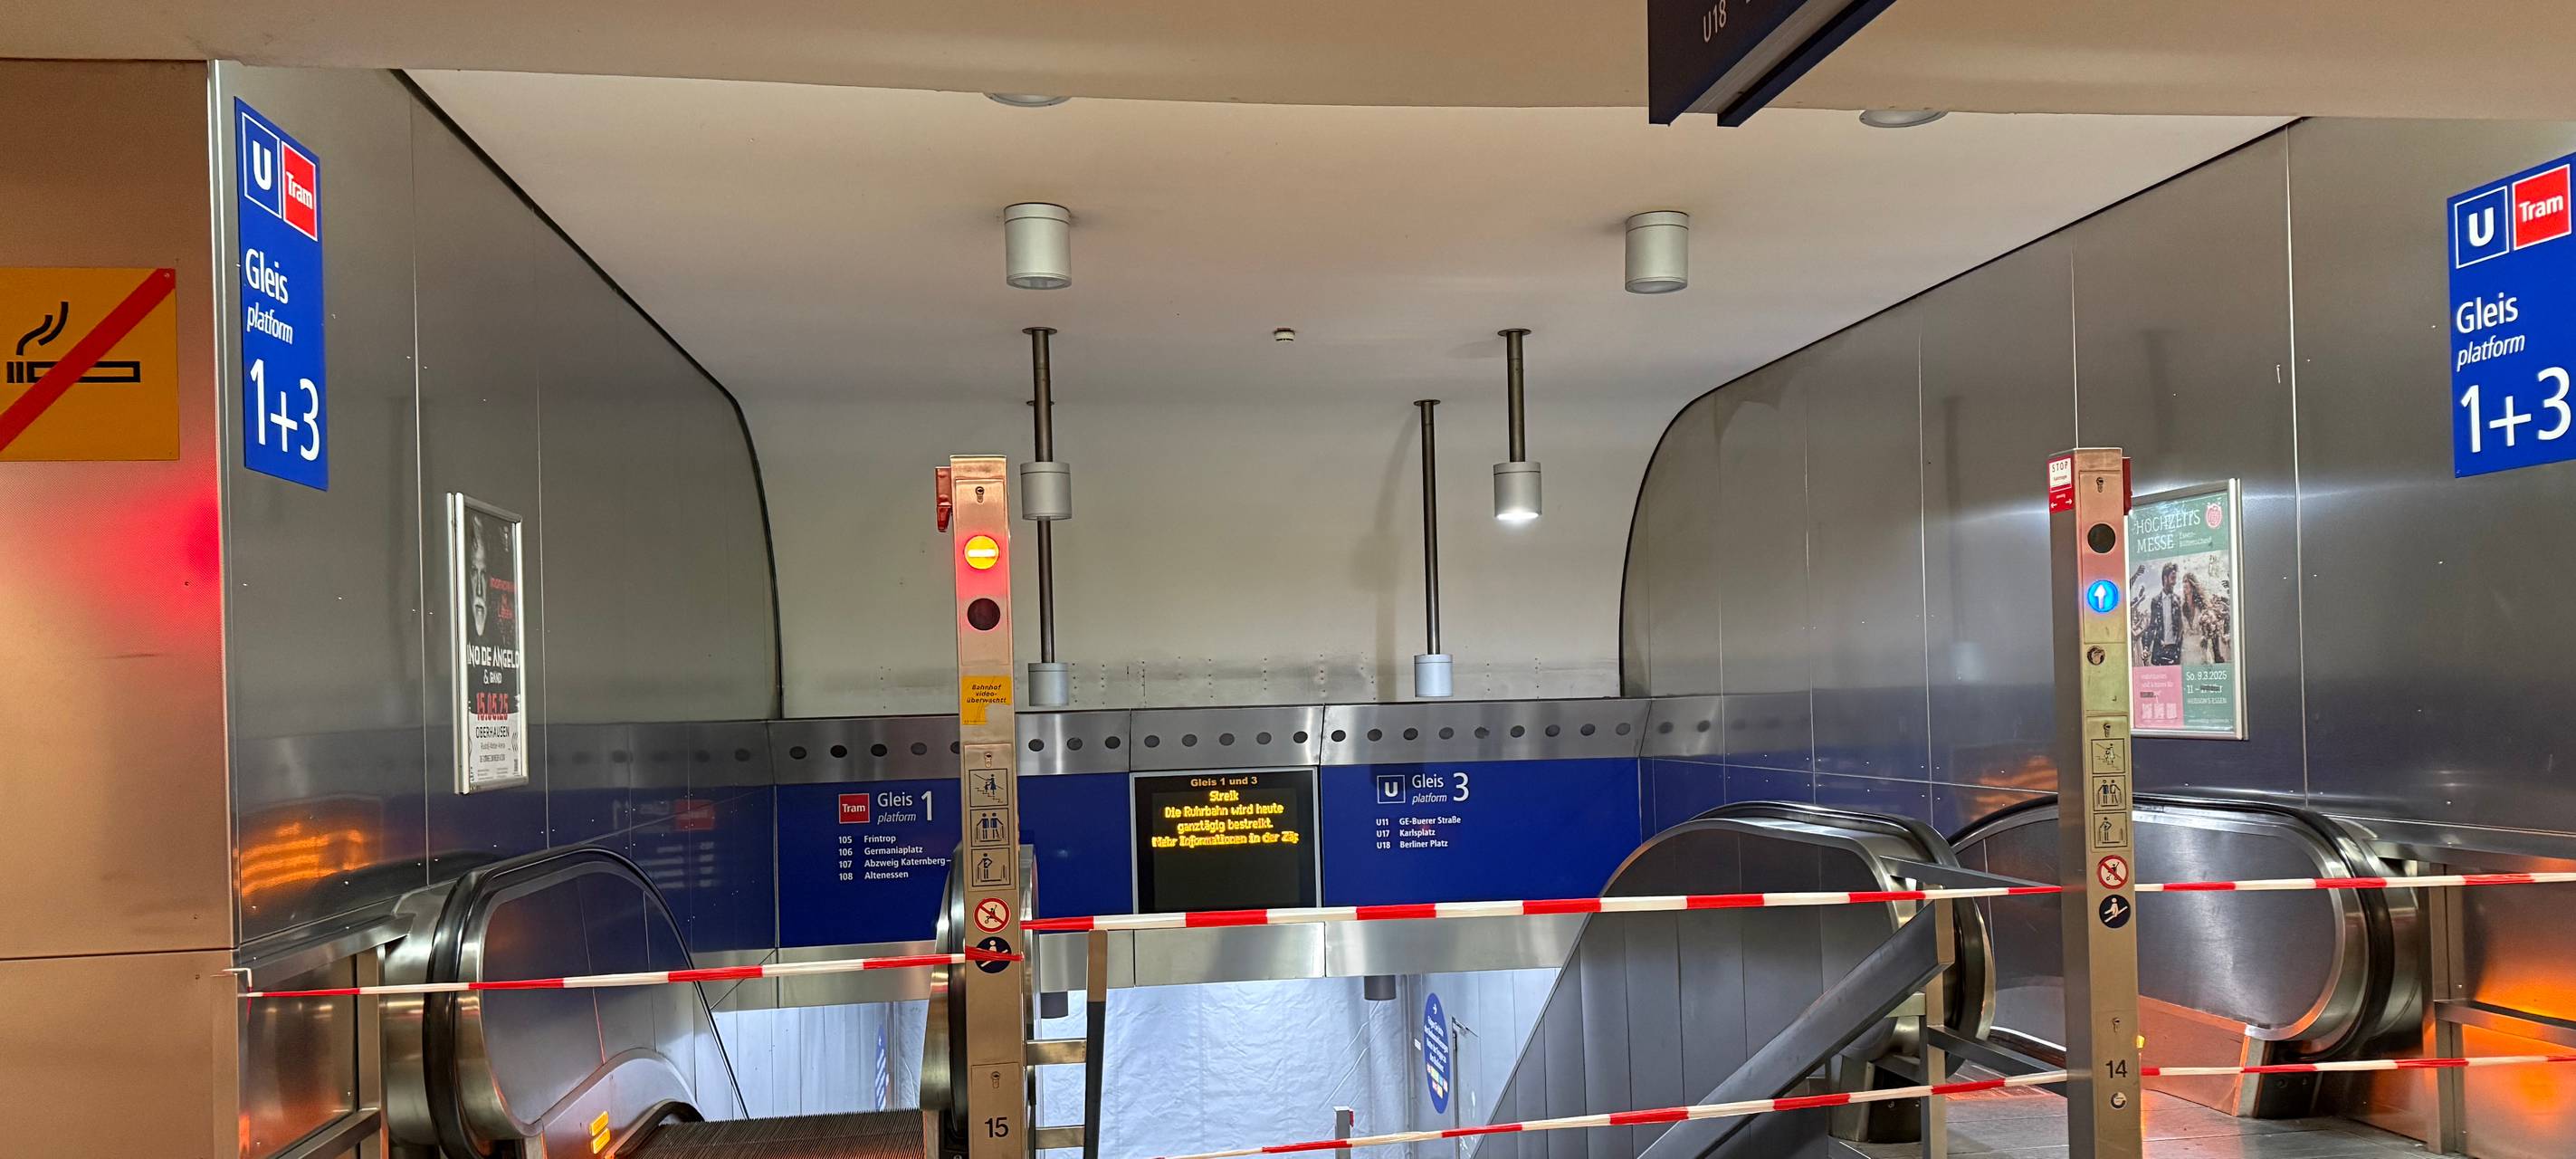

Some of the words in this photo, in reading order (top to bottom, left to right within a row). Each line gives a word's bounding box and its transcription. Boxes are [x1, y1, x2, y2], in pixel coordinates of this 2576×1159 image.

[1703, 0, 1727, 43] U18
[253, 140, 271, 191] U
[286, 169, 313, 211] Tram
[2468, 206, 2495, 248] U
[2519, 194, 2563, 223] Tram
[245, 248, 289, 304] Gleis
[2457, 292, 2519, 334] Gleis
[246, 302, 293, 345] platform
[2456, 332, 2525, 373] platform
[250, 359, 320, 461] 1+3
[2460, 366, 2572, 454] 1+3
[2136, 509, 2201, 534] HOCHZEITS
[2136, 534, 2174, 553] MESSE
[481, 646, 492, 666] DE
[475, 726, 510, 739] OBERHAUSEN
[1190, 778, 1217, 787] Gleis
[1219, 777, 1226, 786] 1
[1229, 776, 1248, 785] und
[1251, 776, 1258, 784] 3
[1385, 781, 1398, 798] U
[1412, 773, 1444, 789] Gleis
[1453, 771, 1470, 802] 3
[1209, 790, 1239, 802] Streik
[1412, 792, 1447, 805] platform
[842, 803, 866, 813] Tram
[877, 791, 913, 808] Gleis
[921, 790, 933, 821] 1
[1165, 806, 1181, 819] Die
[1184, 805, 1228, 818] Ruhrbahn
[1230, 803, 1254, 816] wird
[1255, 802, 1284, 815] heute
[877, 811, 917, 825] platform
[1177, 819, 1226, 835] ganztägig
[1227, 818, 1274, 830] bestreikt.
[1376, 818, 1389, 826] U11
[1399, 817, 1436, 825] GE-Buerer
[1437, 816, 1461, 824] Straße
[838, 836, 853, 844] 105
[863, 835, 896, 844] Frintrop
[1248, 832, 1261, 844] in
[1262, 831, 1280, 843] der
[1376, 829, 1390, 838] U17
[1399, 829, 1436, 838] Karlsplatz
[838, 848, 854, 857] 106
[863, 846, 923, 856] Germaniaplatz
[1376, 841, 1391, 849] U18
[1399, 840, 1428, 848] Berliner
[1430, 839, 1448, 848] Platz
[838, 860, 853, 868] 107
[863, 858, 899, 868] Abzweig
[901, 857, 946, 867] Katernberg
[838, 872, 854, 881] 108
[864, 871, 909, 880] Altenessen
[2105, 1059, 2128, 1078] 14
[985, 1116, 1009, 1138] 15
